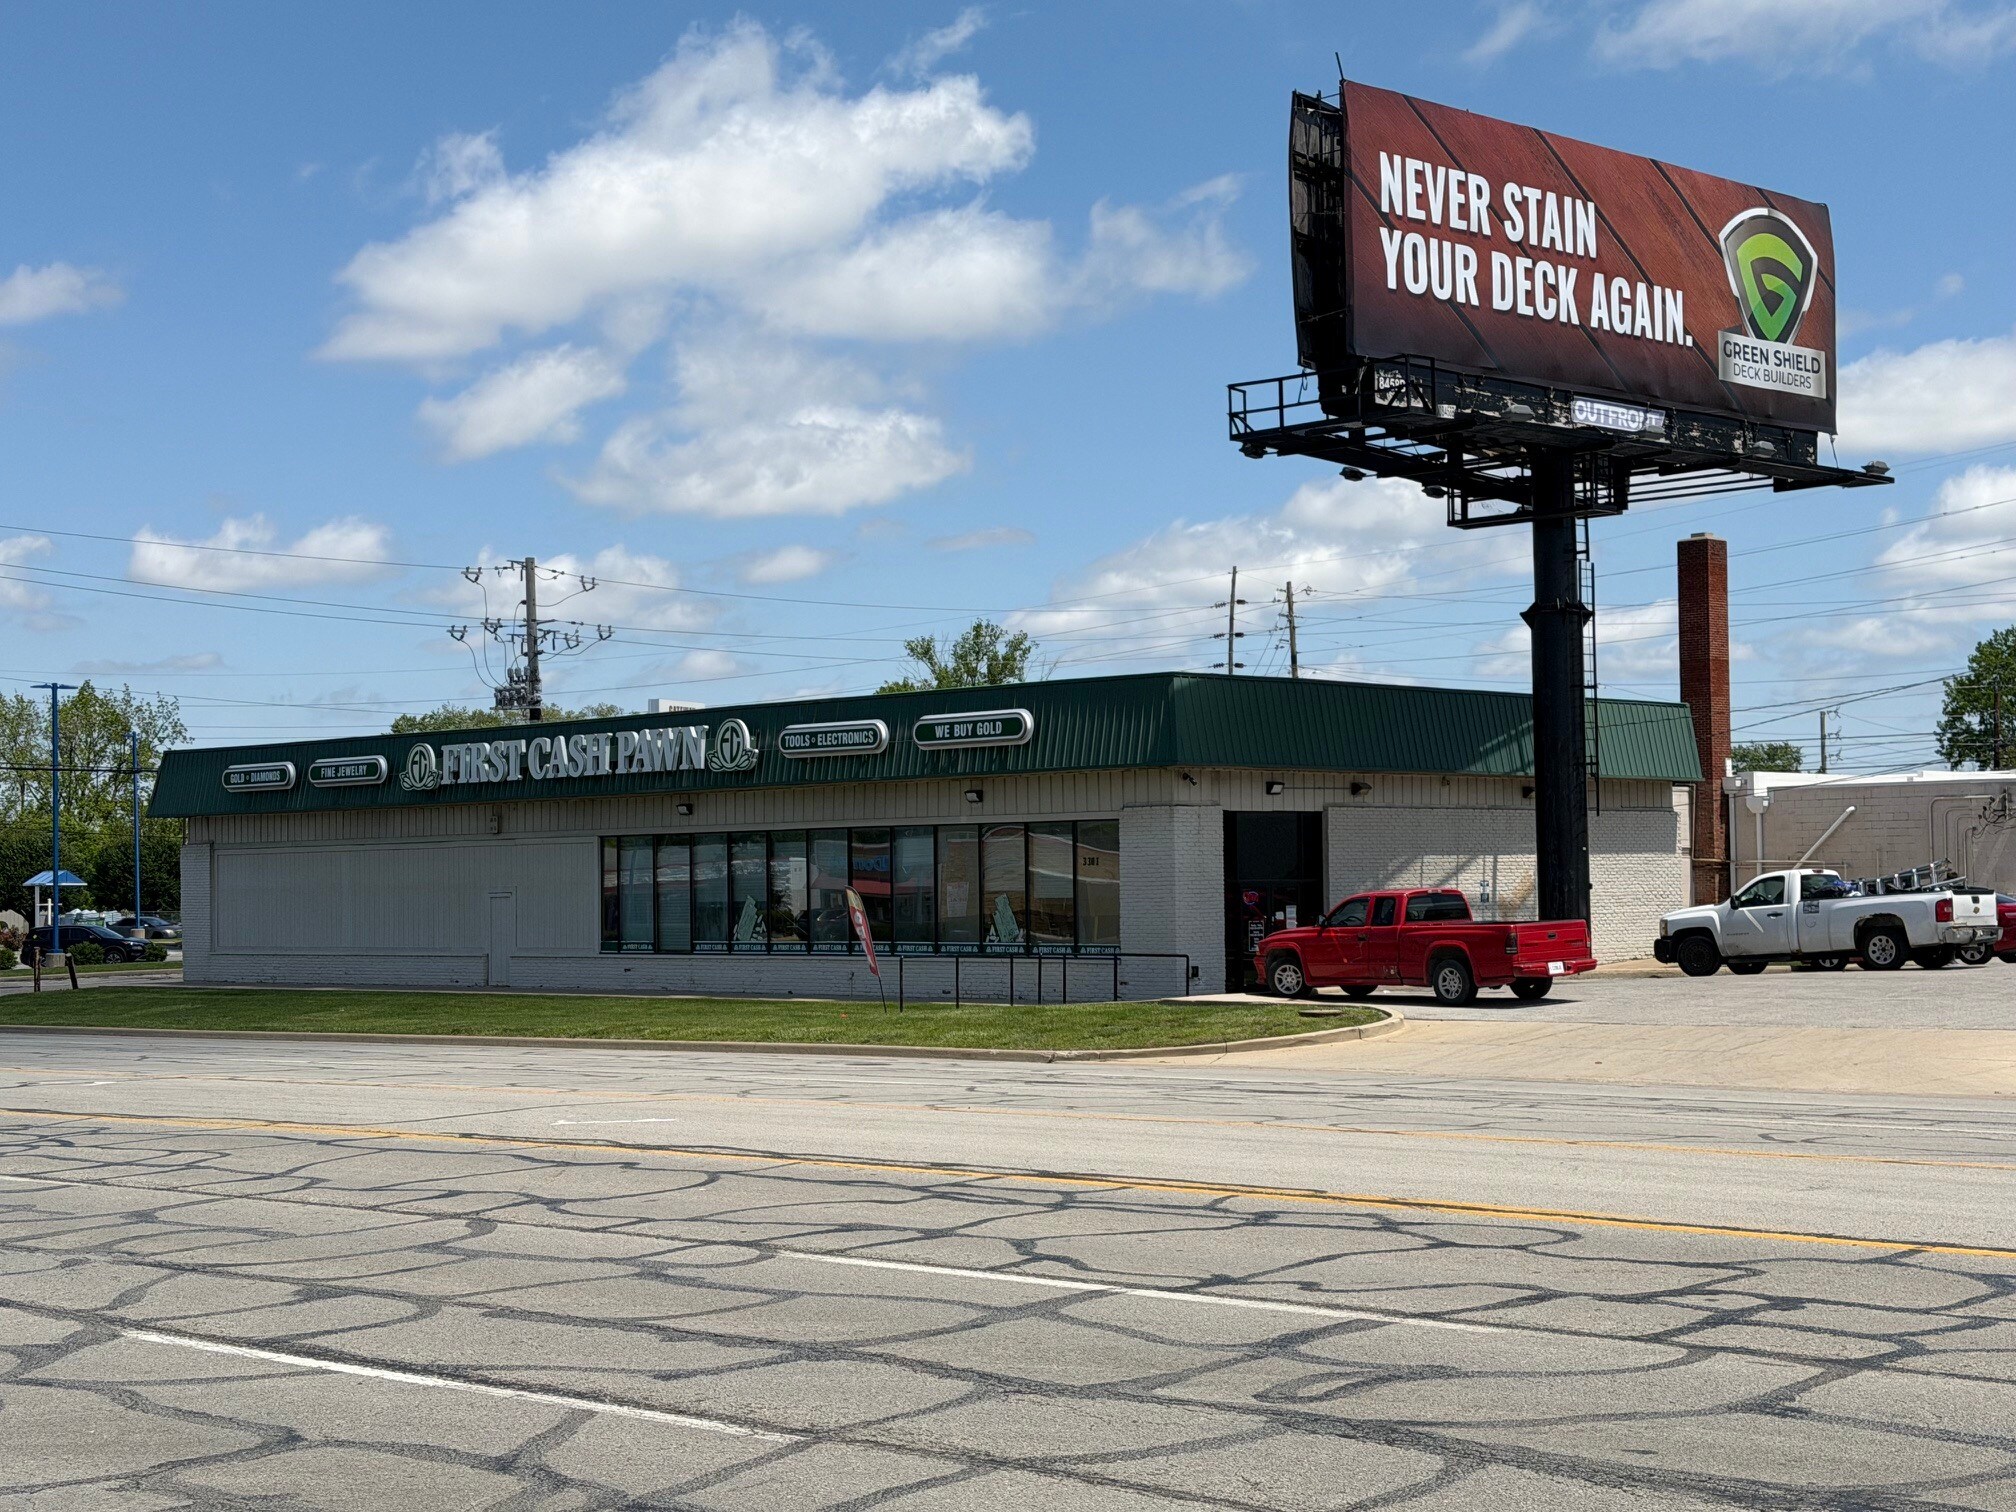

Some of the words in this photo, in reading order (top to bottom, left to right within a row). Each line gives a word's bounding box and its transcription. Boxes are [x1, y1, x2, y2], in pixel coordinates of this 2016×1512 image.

[1380, 151, 1491, 236] NEVER
[1504, 182, 1597, 258] STAIN
[1379, 227, 1479, 307] YOUR
[1491, 252, 1579, 325] DECK
[1591, 272, 1693, 347] AGAIN.
[1723, 340, 1770, 366] GREEN
[1773, 350, 1821, 374] SHIELD
[1733, 363, 1761, 381] DECK
[1763, 369, 1812, 389] BUILDERS
[785, 735, 811, 748] TOOLS
[817, 731, 874, 746] ELECTRONICS
[934, 725, 950, 739] WE
[954, 723, 973, 737] BUY
[976, 721, 1003, 736] GOLD
[440, 739, 526, 785] FIRST
[528, 732, 613, 780] CASH
[615, 725, 710, 774] PAWN
[230, 773, 245, 784] GOLD
[250, 771, 281, 783] DIAMONDS
[320, 767, 336, 778] FINE
[337, 765, 368, 777] JEWELRY
